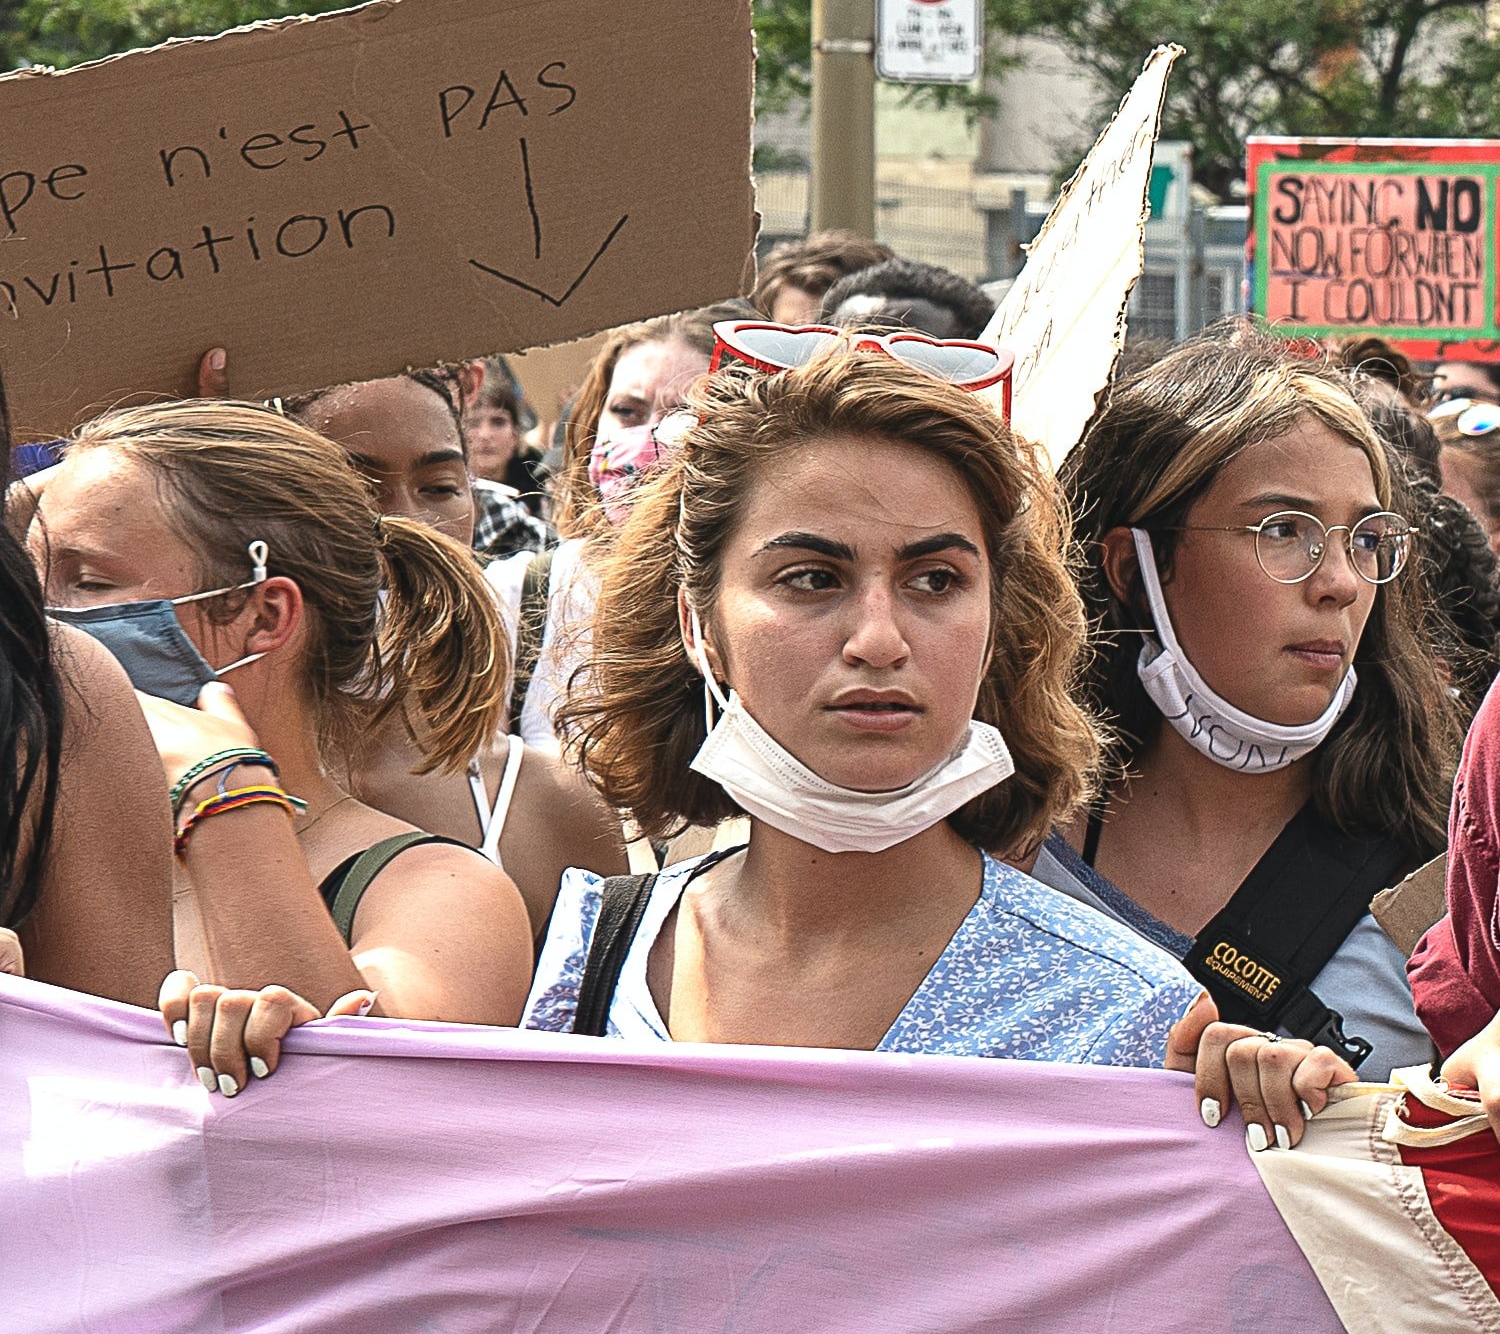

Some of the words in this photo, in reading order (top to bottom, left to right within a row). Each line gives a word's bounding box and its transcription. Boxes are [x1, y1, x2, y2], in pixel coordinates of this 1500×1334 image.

[0, 163, 88, 234] pe
[159, 109, 371, 187] n'est
[438, 61, 579, 138] PAS
[1415, 176, 1482, 233] NO
[0, 203, 396, 312] nvitation
[1271, 225, 1344, 276] NOW
[1286, 278, 1310, 323] I
[1212, 940, 1282, 997] COCOTTE
